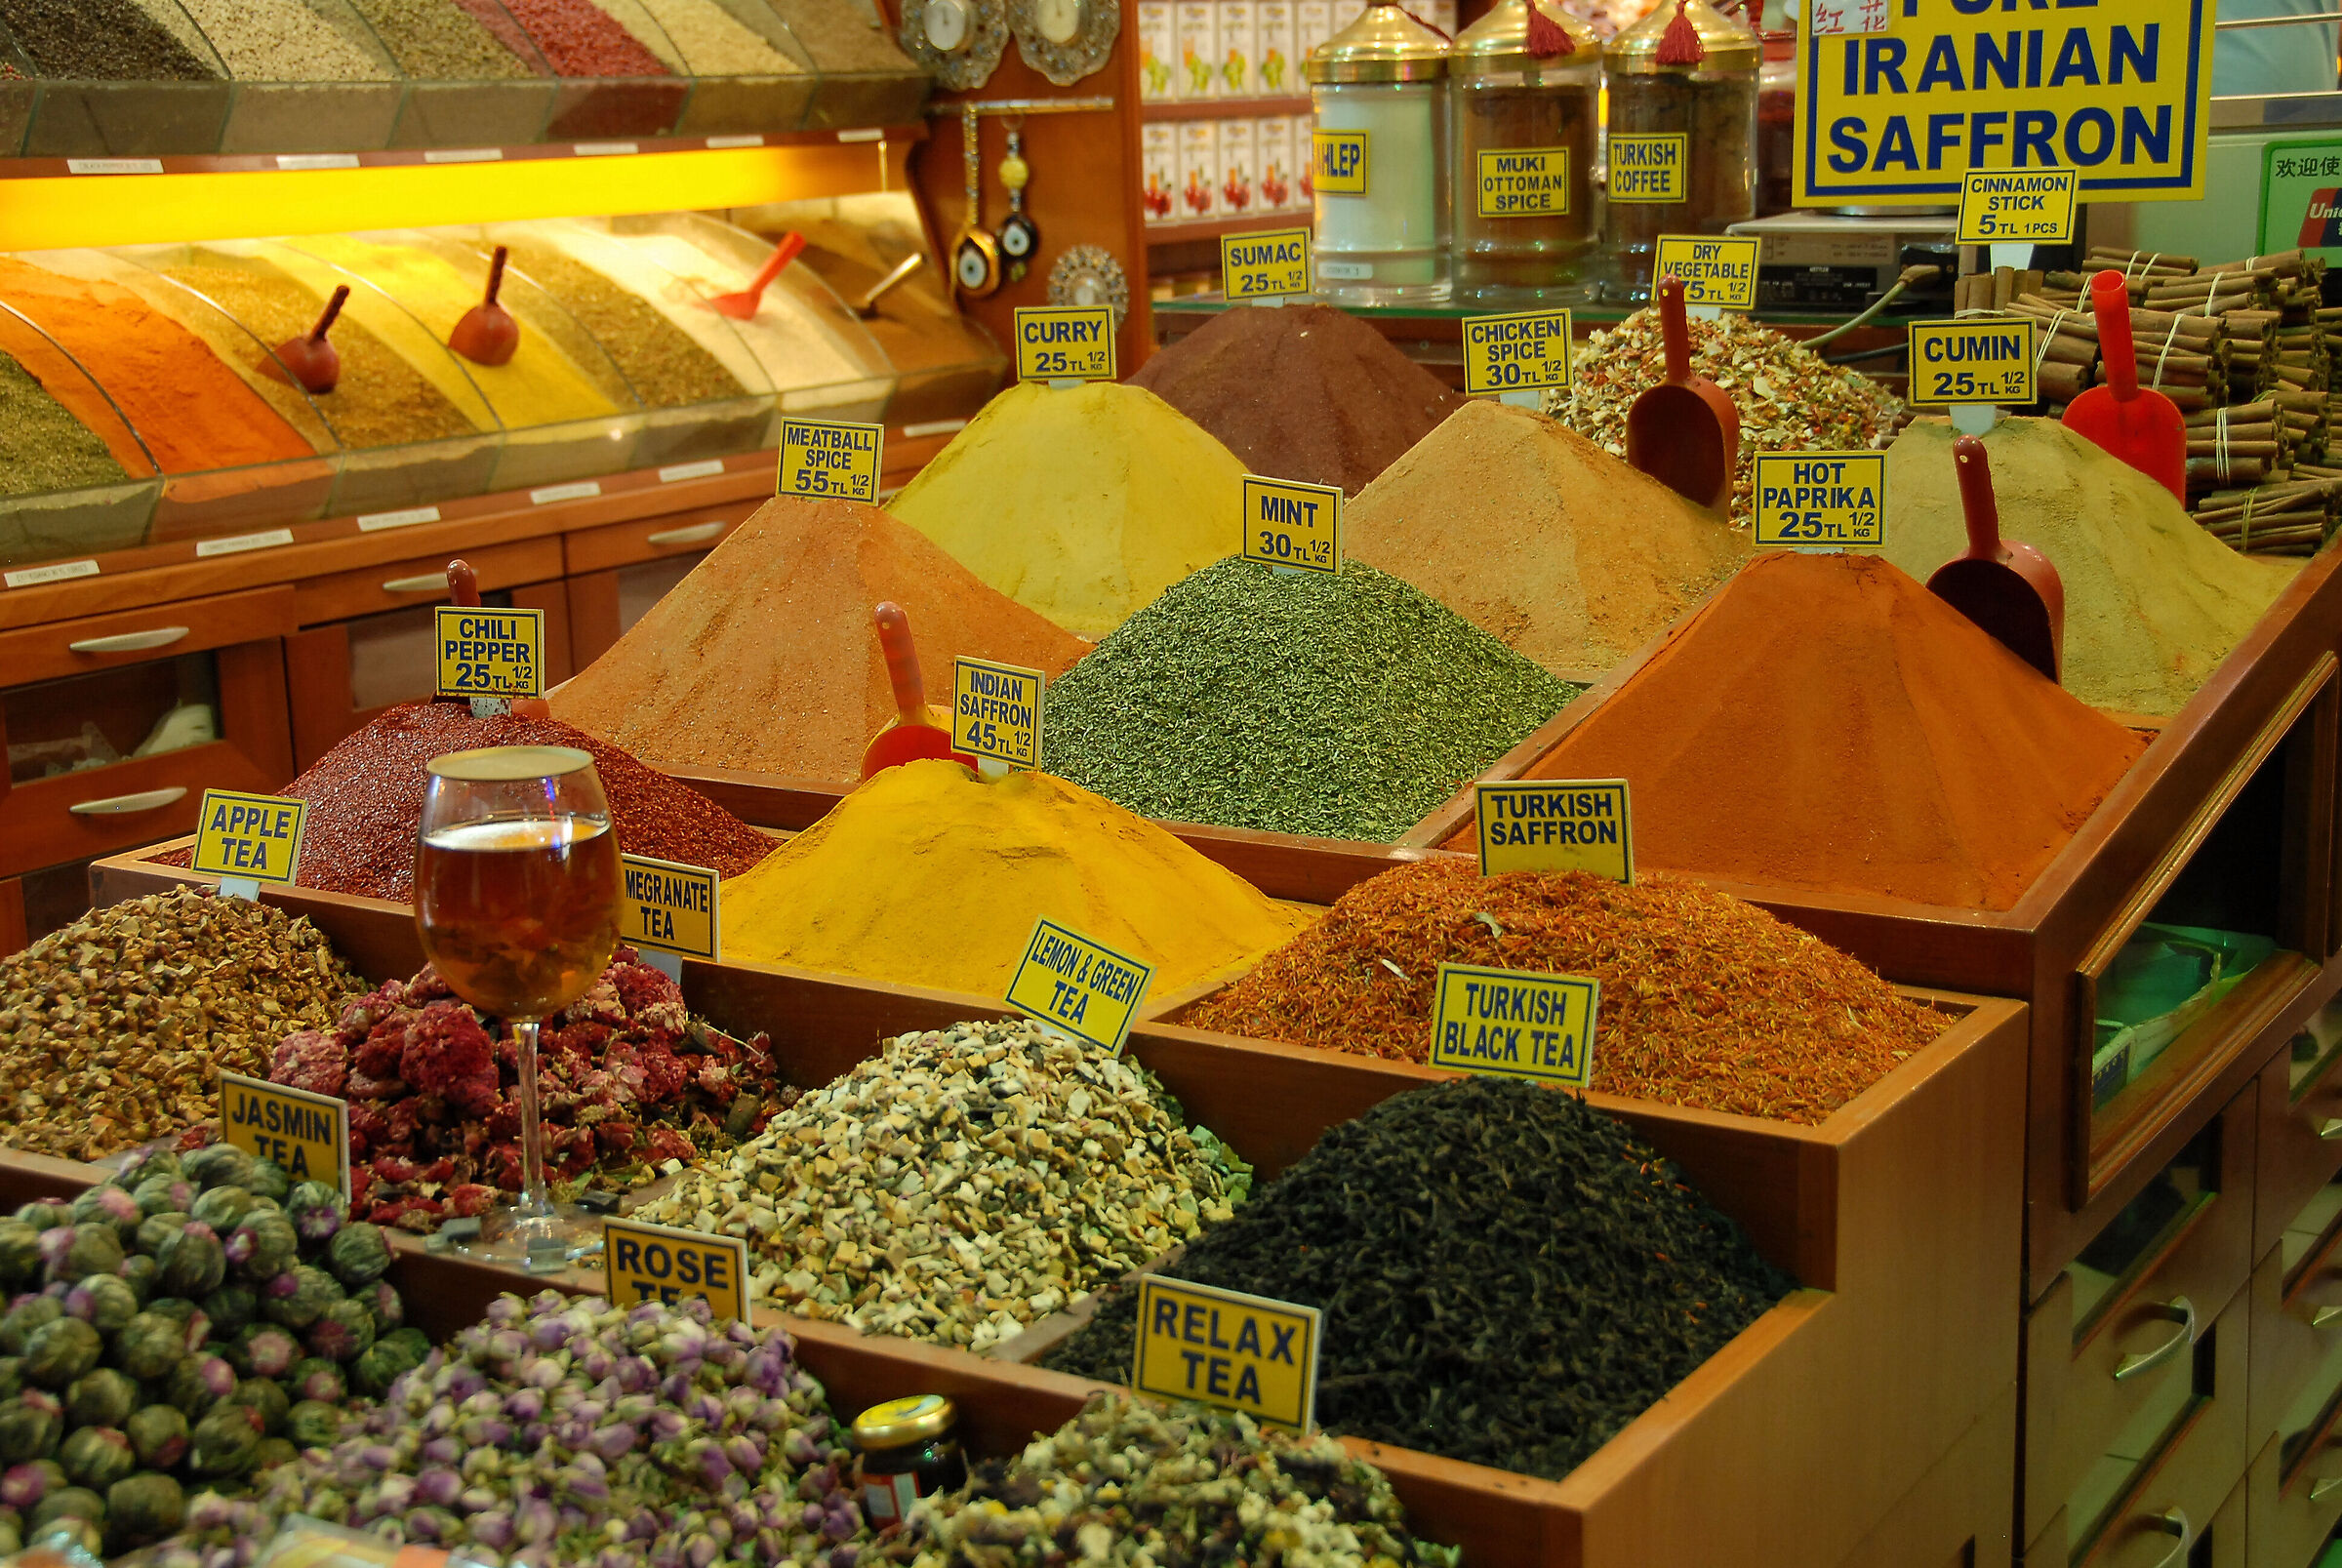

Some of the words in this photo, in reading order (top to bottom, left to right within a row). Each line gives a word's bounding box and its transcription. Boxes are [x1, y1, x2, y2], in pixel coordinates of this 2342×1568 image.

[1843, 23, 2160, 96] IRANIAN
[1828, 104, 2172, 174] SAFFRON
[1497, 156, 1545, 173] MUKI
[1614, 143, 1676, 166] TURKISH
[1483, 175, 1561, 192] OTTOMAN
[1615, 170, 1672, 193] COFFEE
[1971, 177, 2068, 193] CINNAMON
[1496, 194, 1551, 210] SPICE
[1988, 195, 2044, 211] STICK
[1230, 242, 1302, 267] SUMAC
[1693, 244, 1721, 261] DRY
[1288, 270, 1303, 281] 1/2
[1664, 261, 1750, 279] VEGETABLE
[1727, 282, 1747, 293] 1/2
[1024, 320, 1103, 343] CURRY
[1471, 319, 1560, 343] CHICKEN
[1087, 351, 1106, 362] 1/2
[1487, 341, 1546, 363] SPICE
[1923, 335, 2021, 363] CUMIN
[1541, 359, 1561, 373] 1/2
[1545, 373, 1558, 382] KG
[2000, 371, 2025, 384] 1/2
[2004, 385, 2021, 394] KG
[787, 426, 872, 451] MEATBALL
[805, 448, 852, 470] SPICE
[850, 474, 869, 487] 1/2
[1794, 462, 1846, 484] HOT
[852, 487, 866, 496] KG
[1762, 487, 1876, 508] PAPRIKA
[1261, 495, 1318, 528] MINT
[1848, 511, 1875, 526] 1/2
[1853, 528, 1871, 538] KG
[1310, 539, 1330, 554] 1/2
[1314, 553, 1327, 563] KG
[459, 618, 517, 640] CHILI
[445, 640, 531, 663] PEPPER
[511, 665, 533, 679] 1/2
[515, 680, 529, 689] KG
[970, 670, 1023, 702] INDIAN
[959, 693, 1031, 729] SAFFRON
[1014, 730, 1031, 746] 1/2
[1016, 746, 1028, 757] KG
[1491, 792, 1613, 819] TURKISH
[210, 804, 292, 839] APPLE
[1490, 820, 1617, 846] SAFFRON
[222, 837, 267, 870] TEA
[626, 869, 708, 913] MEGRANATE
[640, 905, 675, 941] TEA
[1030, 931, 1082, 979] LEMON
[1075, 953, 1093, 984] &
[1089, 958, 1140, 1005] GREEN
[1048, 980, 1089, 1025] TEA
[1466, 983, 1567, 1026] TURKISH
[1443, 1021, 1521, 1063] BLACK
[1530, 1029, 1574, 1068] TEA
[231, 1092, 331, 1146] JASMIN
[255, 1134, 309, 1178] TEA
[617, 1236, 728, 1290] ROSE
[1153, 1297, 1296, 1366] RELAX
[1182, 1349, 1262, 1405] TEA
